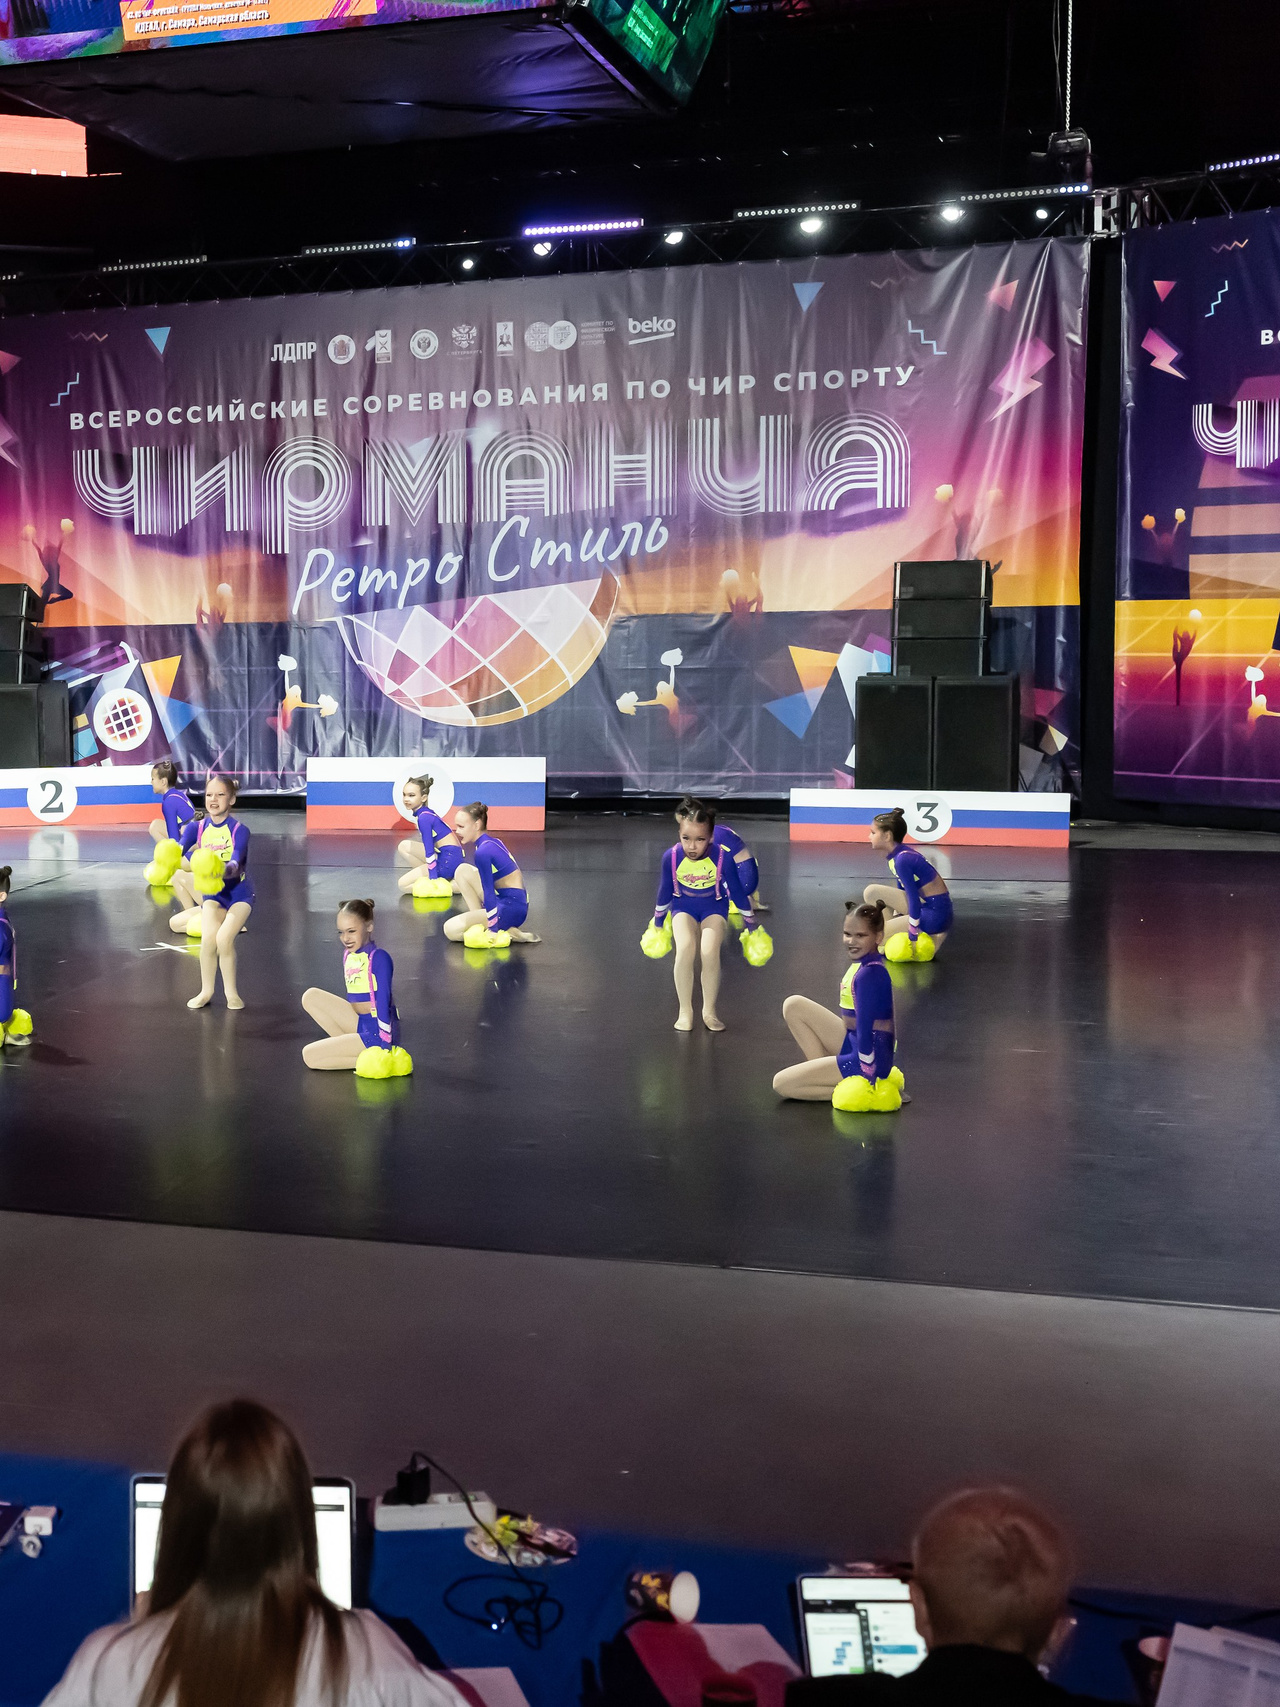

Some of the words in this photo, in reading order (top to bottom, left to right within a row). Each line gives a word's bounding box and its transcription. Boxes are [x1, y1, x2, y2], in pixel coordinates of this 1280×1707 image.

[628, 316, 677, 334] beko
[1260, 329, 1280, 345] В
[270, 341, 317, 364] ЛДПР
[69, 396, 328, 430] ВСЕРОССИЙСКИЕ
[343, 382, 609, 415] СОРЕВНОВАНИЯ
[626, 379, 671, 400] ПО
[688, 374, 757, 396] ЧИР
[774, 365, 916, 392] СПОРТУ
[292, 546, 464, 616] Ретро
[487, 513, 670, 582] Стиль
[39, 779, 65, 814] 2
[916, 802, 939, 833] 3
